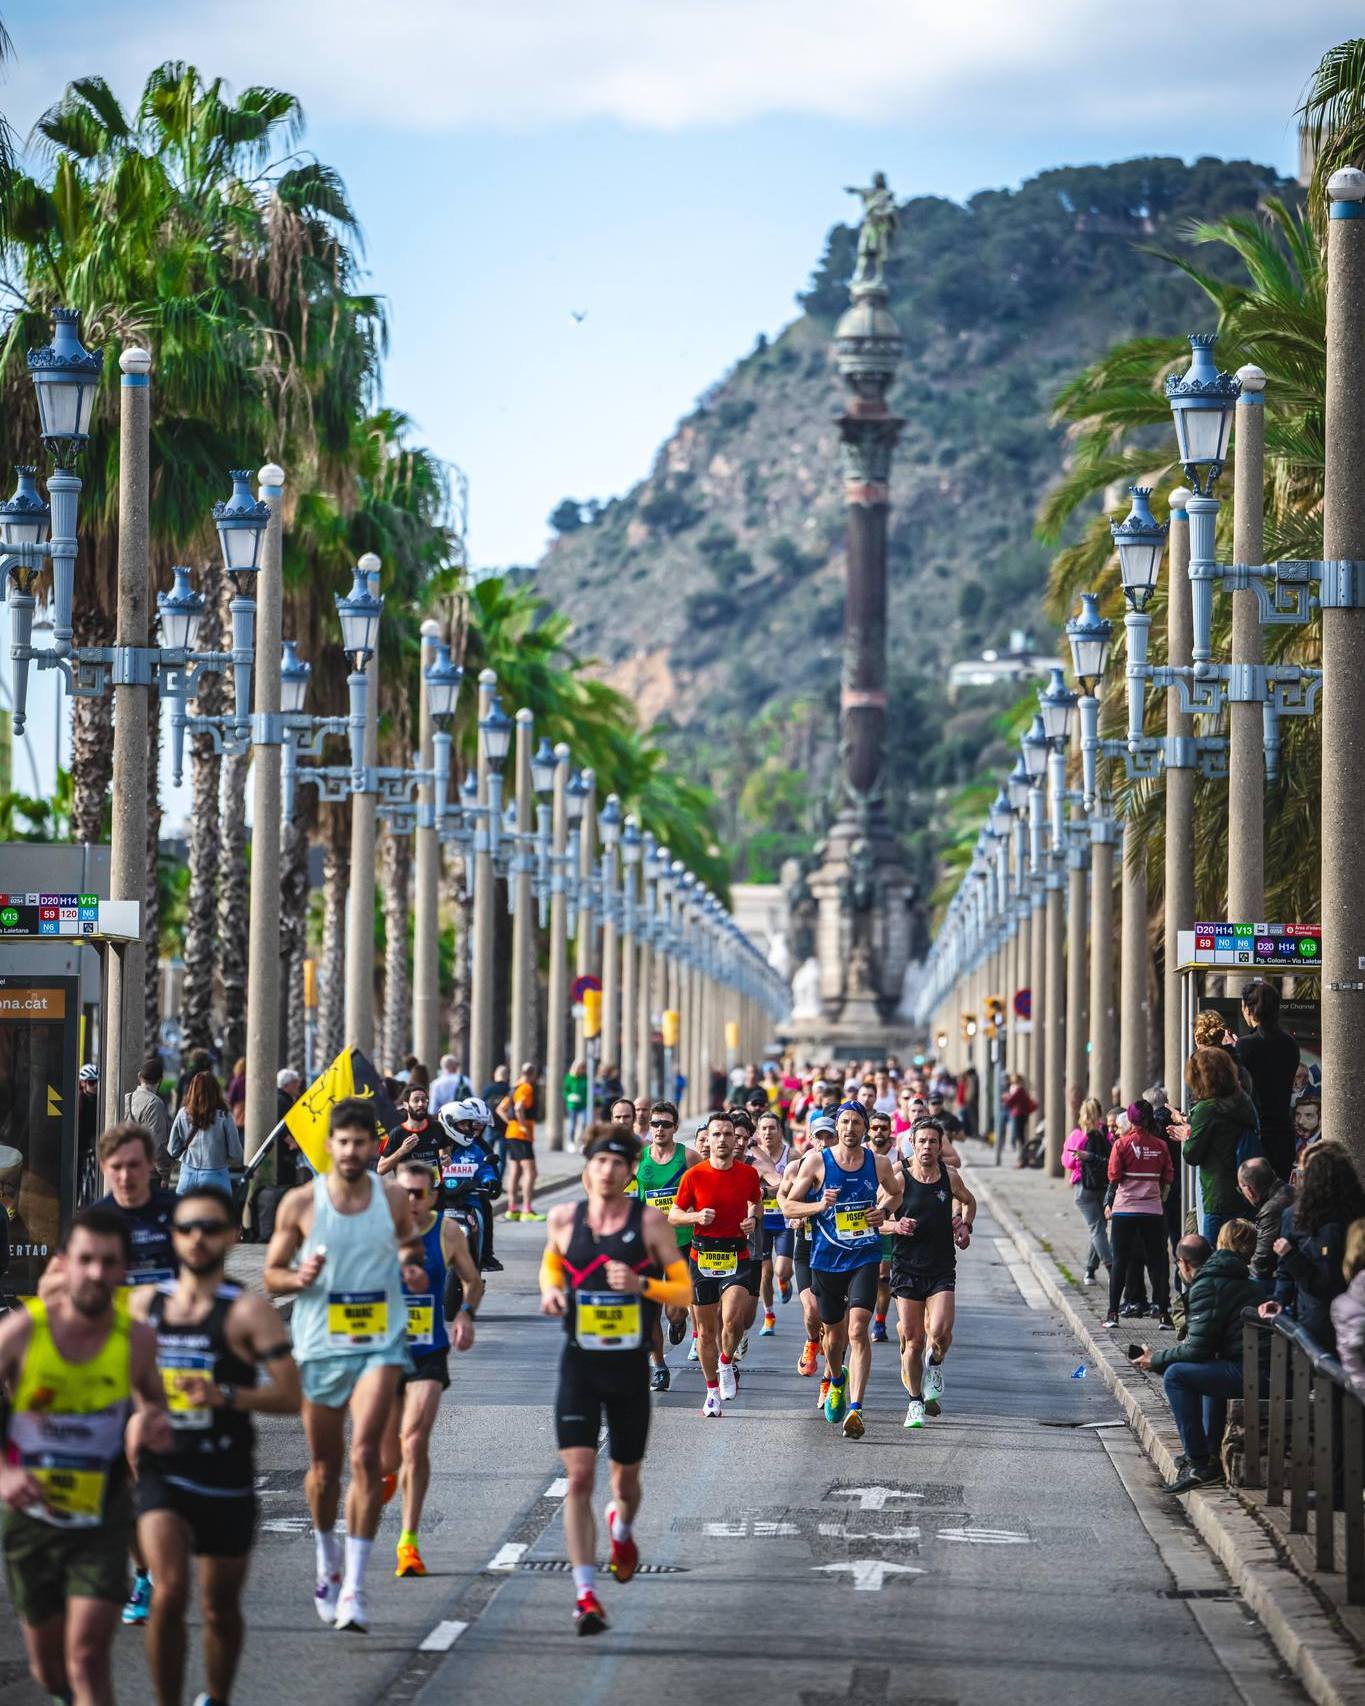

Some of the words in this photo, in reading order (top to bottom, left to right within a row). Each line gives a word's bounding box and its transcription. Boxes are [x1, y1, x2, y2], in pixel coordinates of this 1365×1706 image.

[41, 897, 59, 905] D20
[60, 897, 78, 905] H14
[81, 897, 97, 905] V13
[2, 913, 18, 921] V13
[44, 911, 55, 919] 59
[43, 923, 55, 931] N6
[1196, 926, 1214, 934] D20
[1216, 926, 1233, 935] H14
[1236, 926, 1252, 935] V13
[1200, 939, 1210, 947] 59
[1238, 939, 1249, 947] N6
[1257, 943, 1274, 951] D20
[1279, 943, 1295, 951] H14
[1300, 943, 1316, 951] V13
[655, 1197, 673, 1207] CHRIS
[846, 1212, 865, 1222] JOSEP
[705, 1253, 730, 1261] JORDAN
